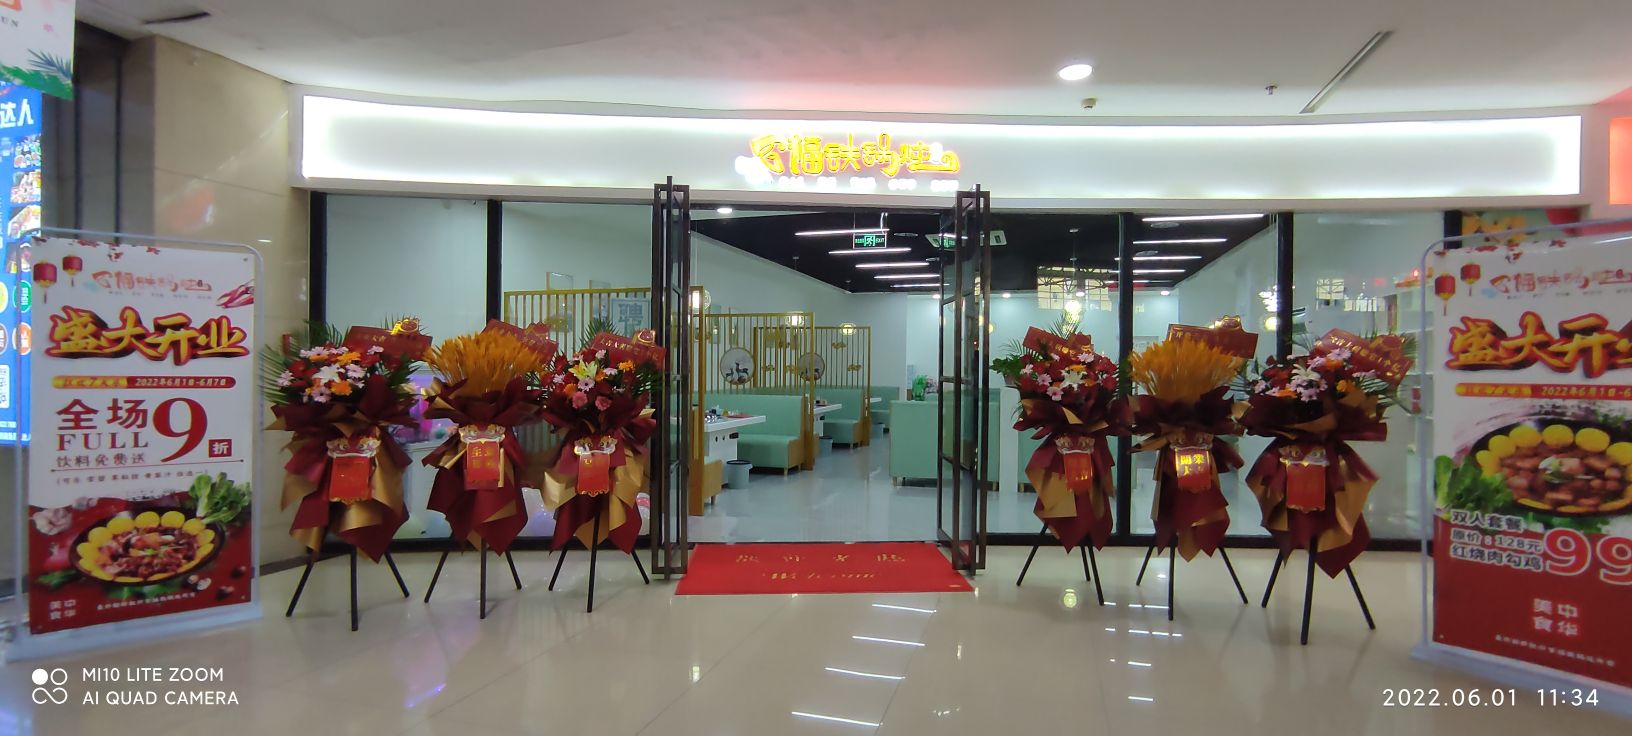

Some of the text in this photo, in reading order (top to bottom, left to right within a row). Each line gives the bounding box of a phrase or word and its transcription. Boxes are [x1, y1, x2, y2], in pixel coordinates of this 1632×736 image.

[45, 305, 250, 366] 盛大开业
[135, 377, 227, 386] 2022年6月1日-6月7日
[56, 398, 148, 430] 全场
[153, 397, 208, 462] 9
[56, 431, 149, 451] FULL
[211, 441, 229, 456] 折
[56, 453, 145, 468] 饮料免费送
[1451, 509, 1523, 532] 双人套餐
